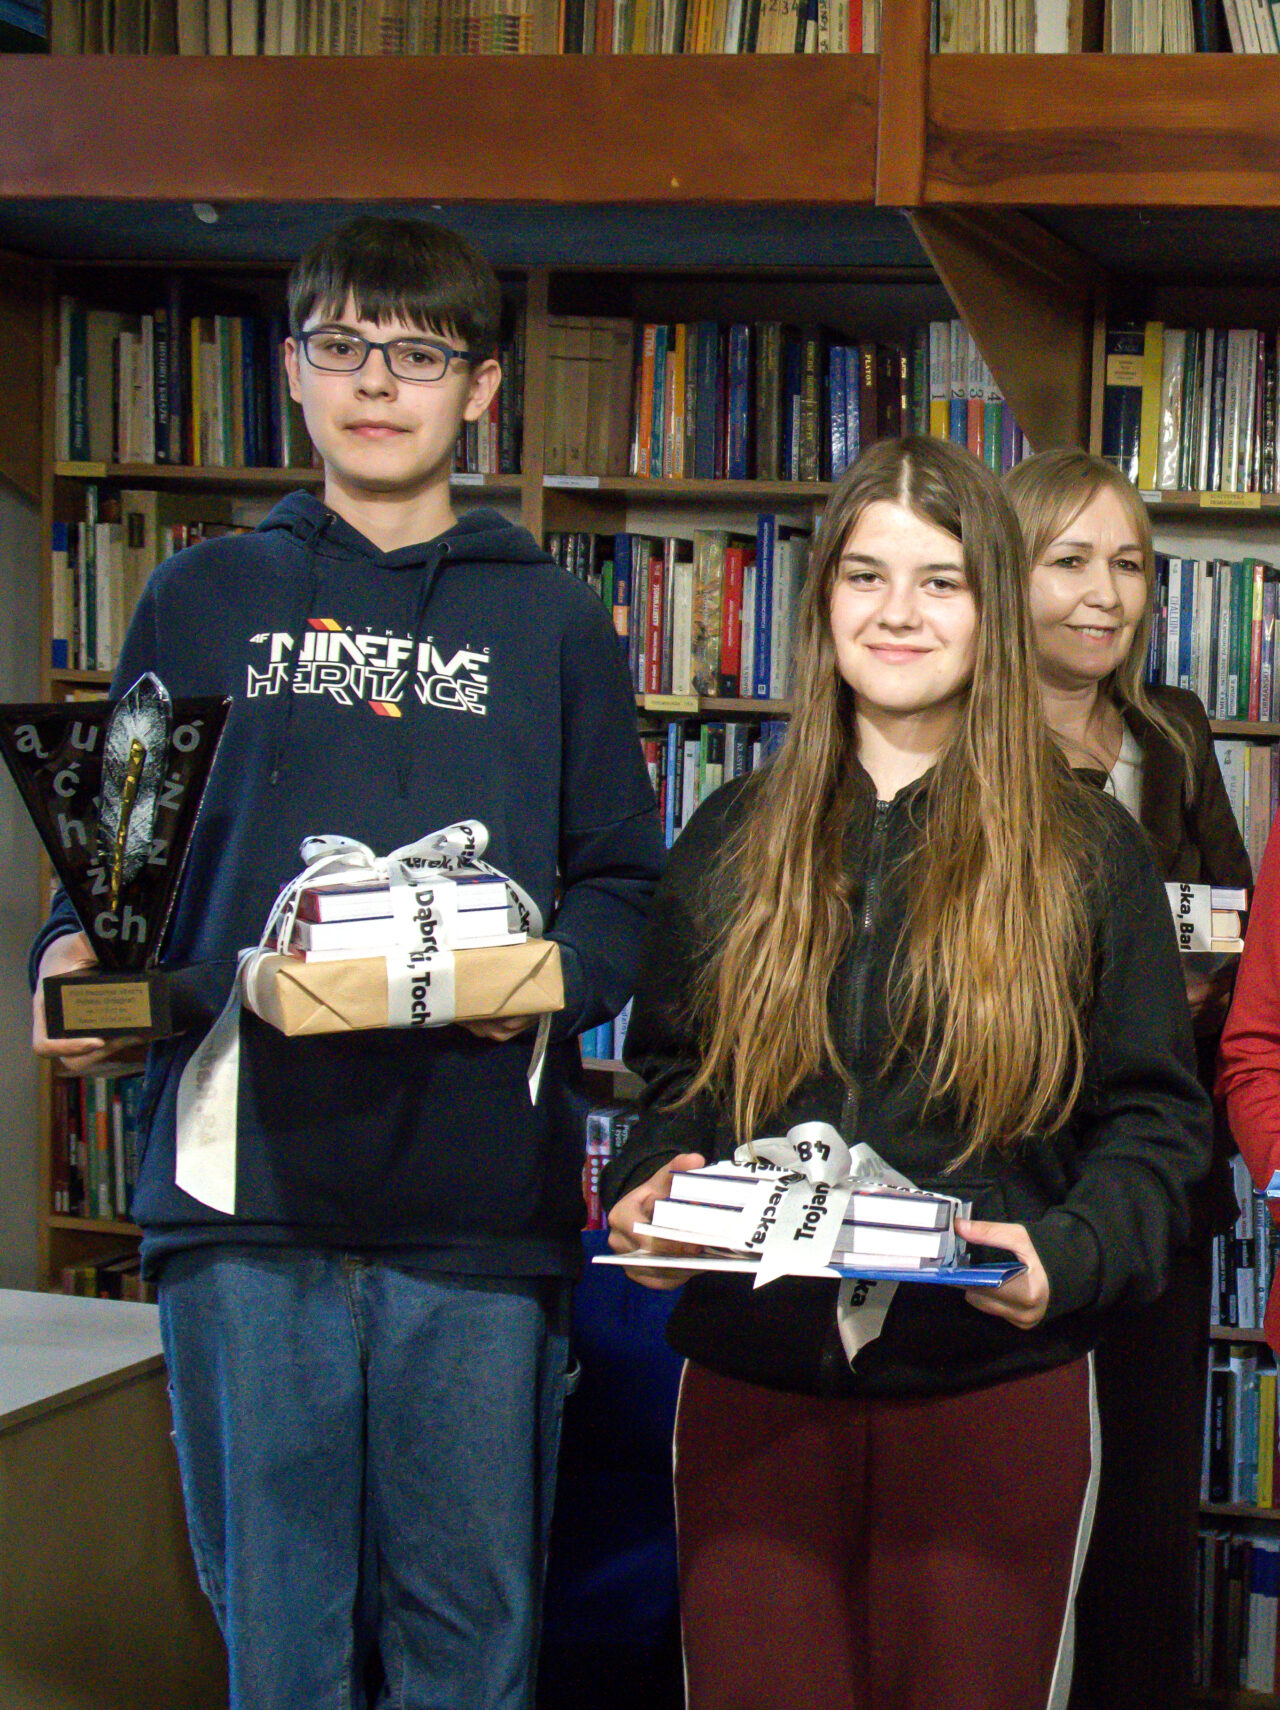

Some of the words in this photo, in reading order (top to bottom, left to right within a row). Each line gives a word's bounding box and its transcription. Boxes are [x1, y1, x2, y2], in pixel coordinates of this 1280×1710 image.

[345, 625, 491, 654] ATHLEIC
[14, 723, 49, 759] ą
[70, 721, 98, 752] u
[172, 719, 205, 752] ó
[53, 762, 80, 798] ć
[57, 813, 88, 849] h
[94, 905, 147, 943] ch
[793, 1182, 831, 1241] Trojan
